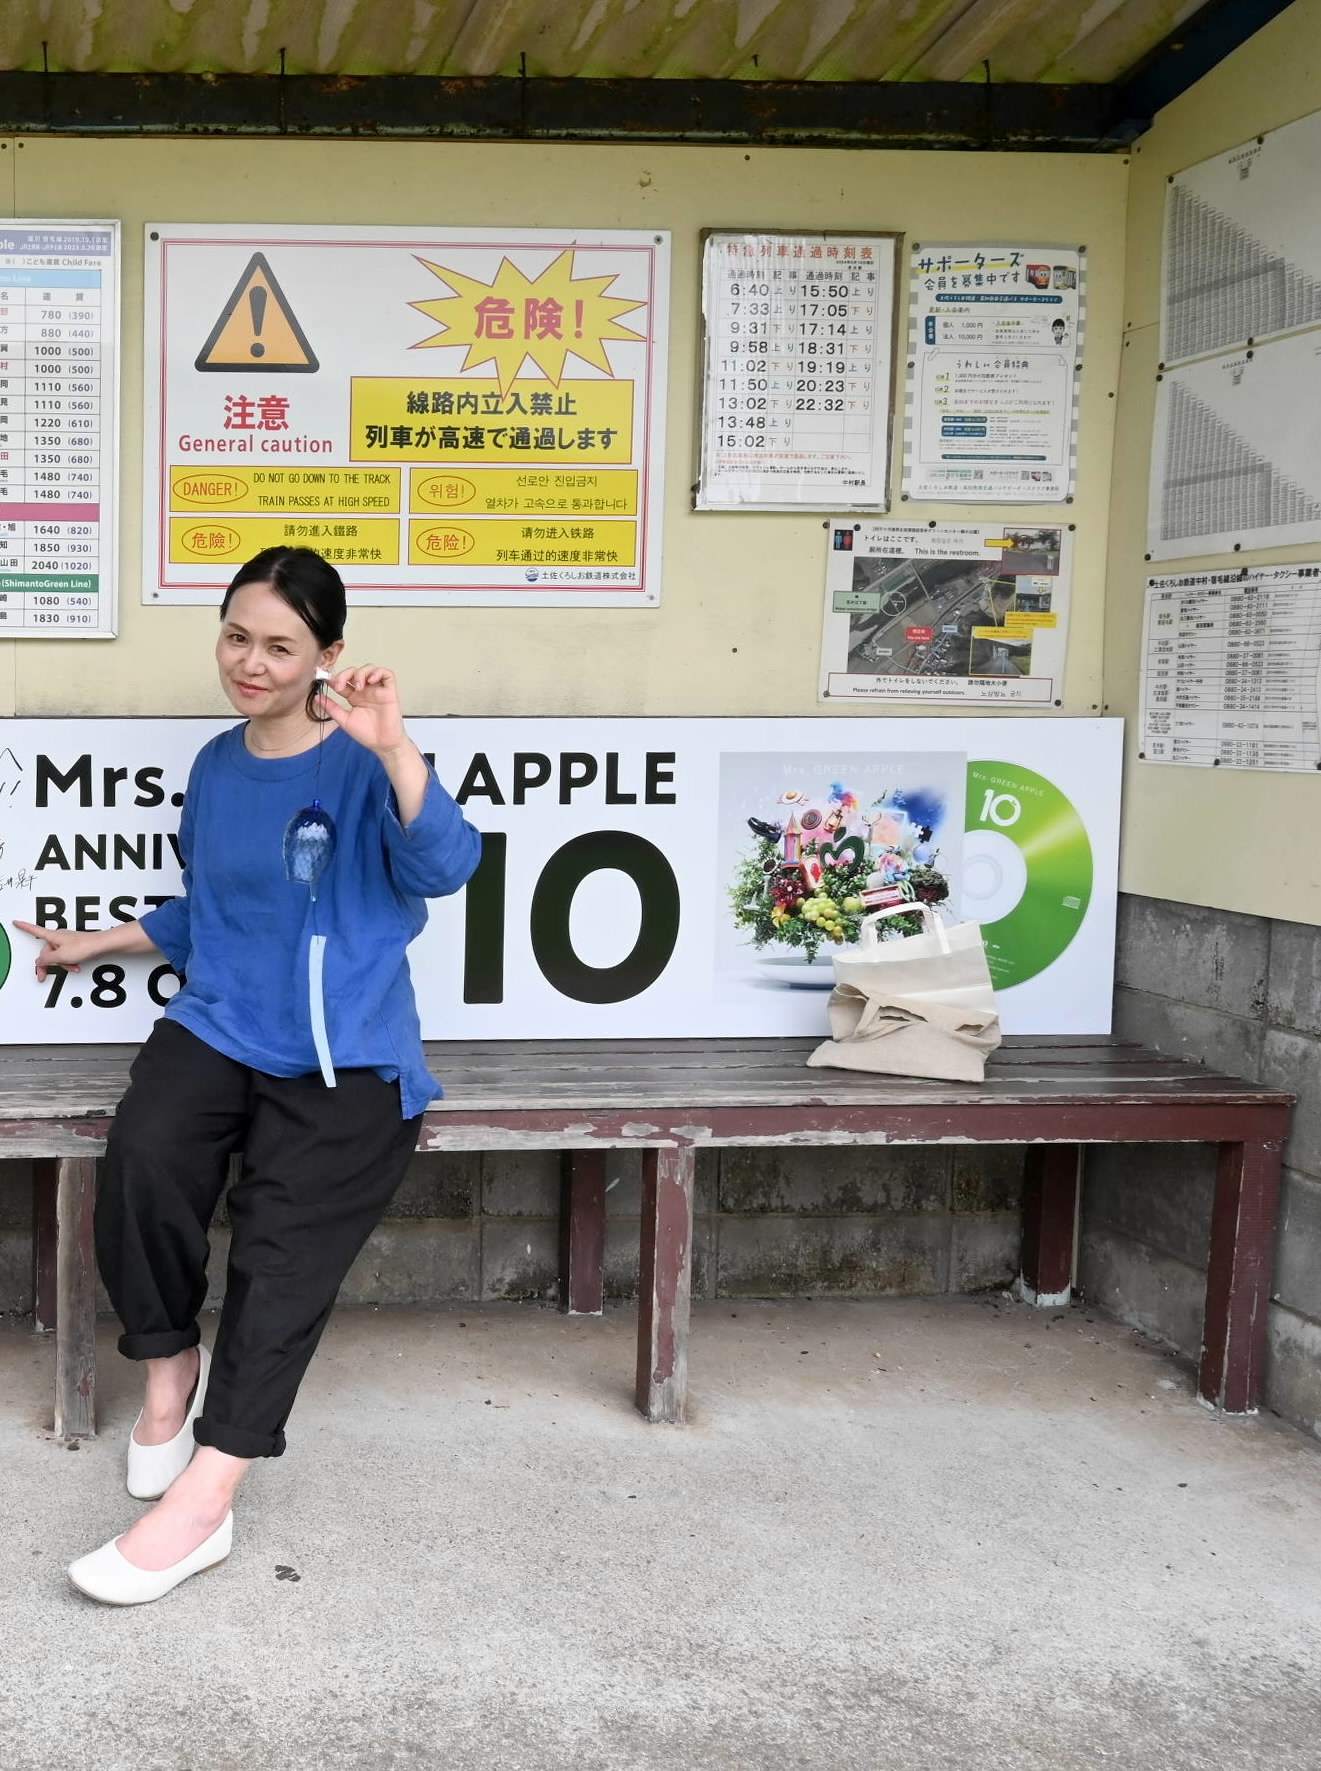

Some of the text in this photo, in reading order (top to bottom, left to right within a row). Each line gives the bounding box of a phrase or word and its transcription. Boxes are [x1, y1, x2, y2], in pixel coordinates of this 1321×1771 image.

[917, 252, 1024, 273] サポーターズ
[924, 271, 1021, 291] 会員を募集中です
[730, 284, 849, 298] 6:40 15:50
[731, 303, 847, 317] 7:33 17:05
[473, 296, 585, 341] 危険!
[730, 322, 846, 336] 9:31 17:14
[730, 341, 844, 355] 9:58 18:31
[35, 364, 61, 374] 1000
[721, 360, 845, 374] 11:02 19:19
[720, 378, 845, 393] 11:50 20:23
[406, 391, 577, 416] 線路内立入禁止
[719, 398, 844, 411] 13:02 22:32
[223, 395, 290, 431] 注意
[718, 416, 766, 429] 13:48
[35, 437, 61, 446] 1350
[178, 435, 333, 454] General caution
[365, 425, 618, 451] 列車が高速で通過します
[718, 435, 765, 448] 15:02
[253, 473, 391, 484] DO NOT GO DOWN TO THE TRACK
[516, 475, 598, 487] 선로안 진입금지
[183, 482, 238, 496] DANGER!
[429, 484, 465, 499] 위험!
[258, 496, 390, 507] TRAIN PASSES AT HIGH SPEED
[485, 498, 628, 510] 열차가 고속으로 통과합니다
[521, 527, 594, 539] 请勿进入铁路
[191, 532, 232, 549] 危險!
[426, 534, 466, 551] 危险!
[496, 549, 618, 562] 列车通过的速度非常快
[32, 561, 58, 570] 2040
[541, 572, 636, 581] 土佐くろしお鉄道株式会社
[36, 752, 677, 808] Mrs. APPLE
[980, 789, 1021, 826] 10
[463, 830, 680, 1004] 10
